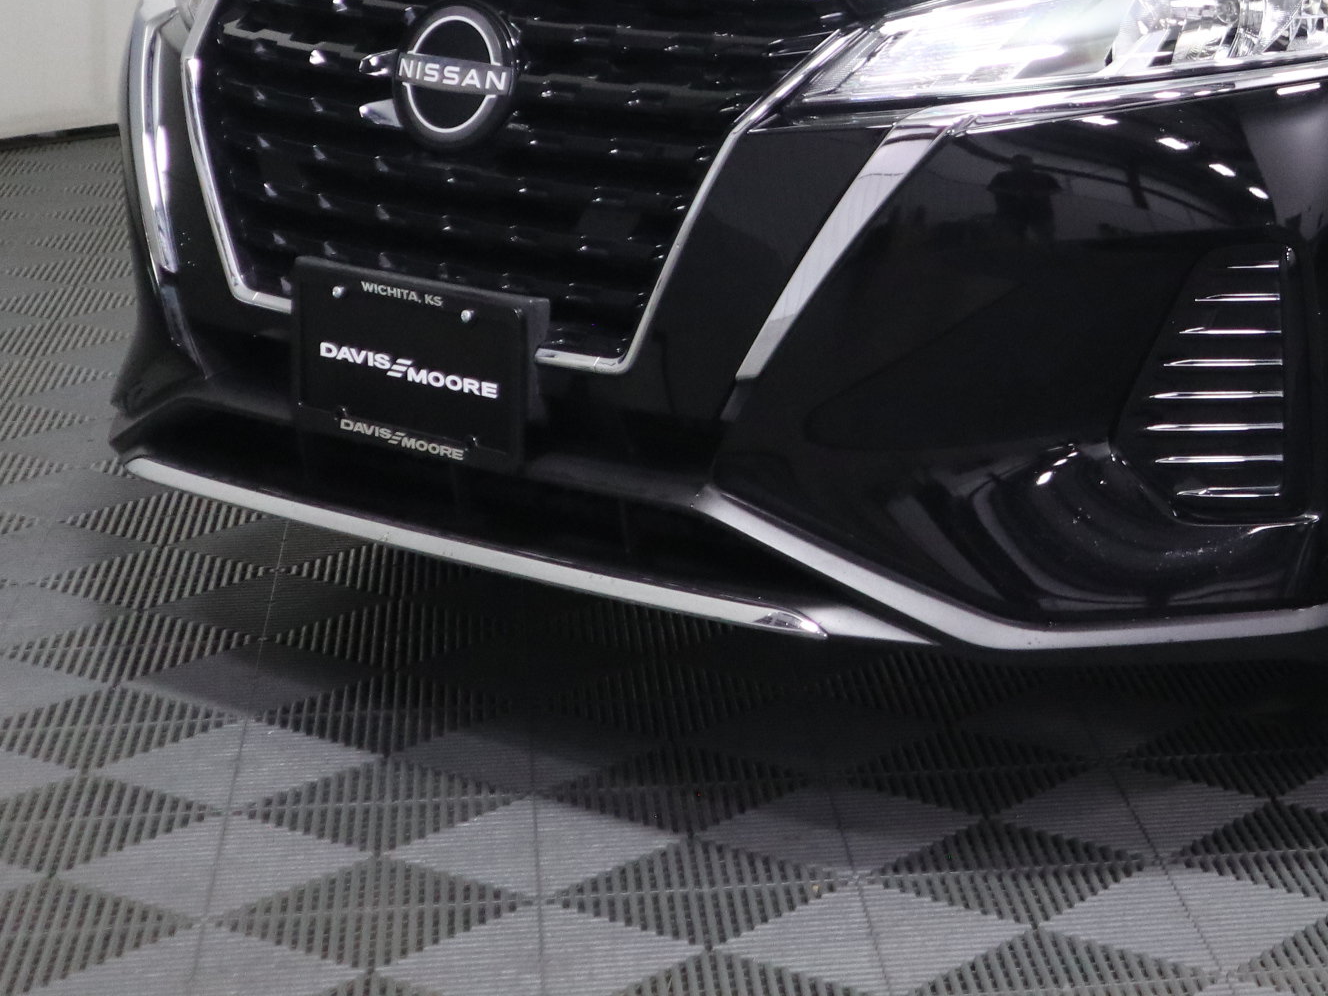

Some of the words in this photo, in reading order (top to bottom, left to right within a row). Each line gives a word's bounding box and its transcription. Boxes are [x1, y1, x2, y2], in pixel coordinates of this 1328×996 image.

[399, 57, 507, 91] NISSAN
[361, 281, 422, 304] WICHITA,
[425, 294, 444, 307] KS
[320, 342, 391, 370] DAVIS
[407, 366, 499, 399] MOORE
[340, 418, 391, 441] DAVIS
[401, 437, 464, 461] MOORE
